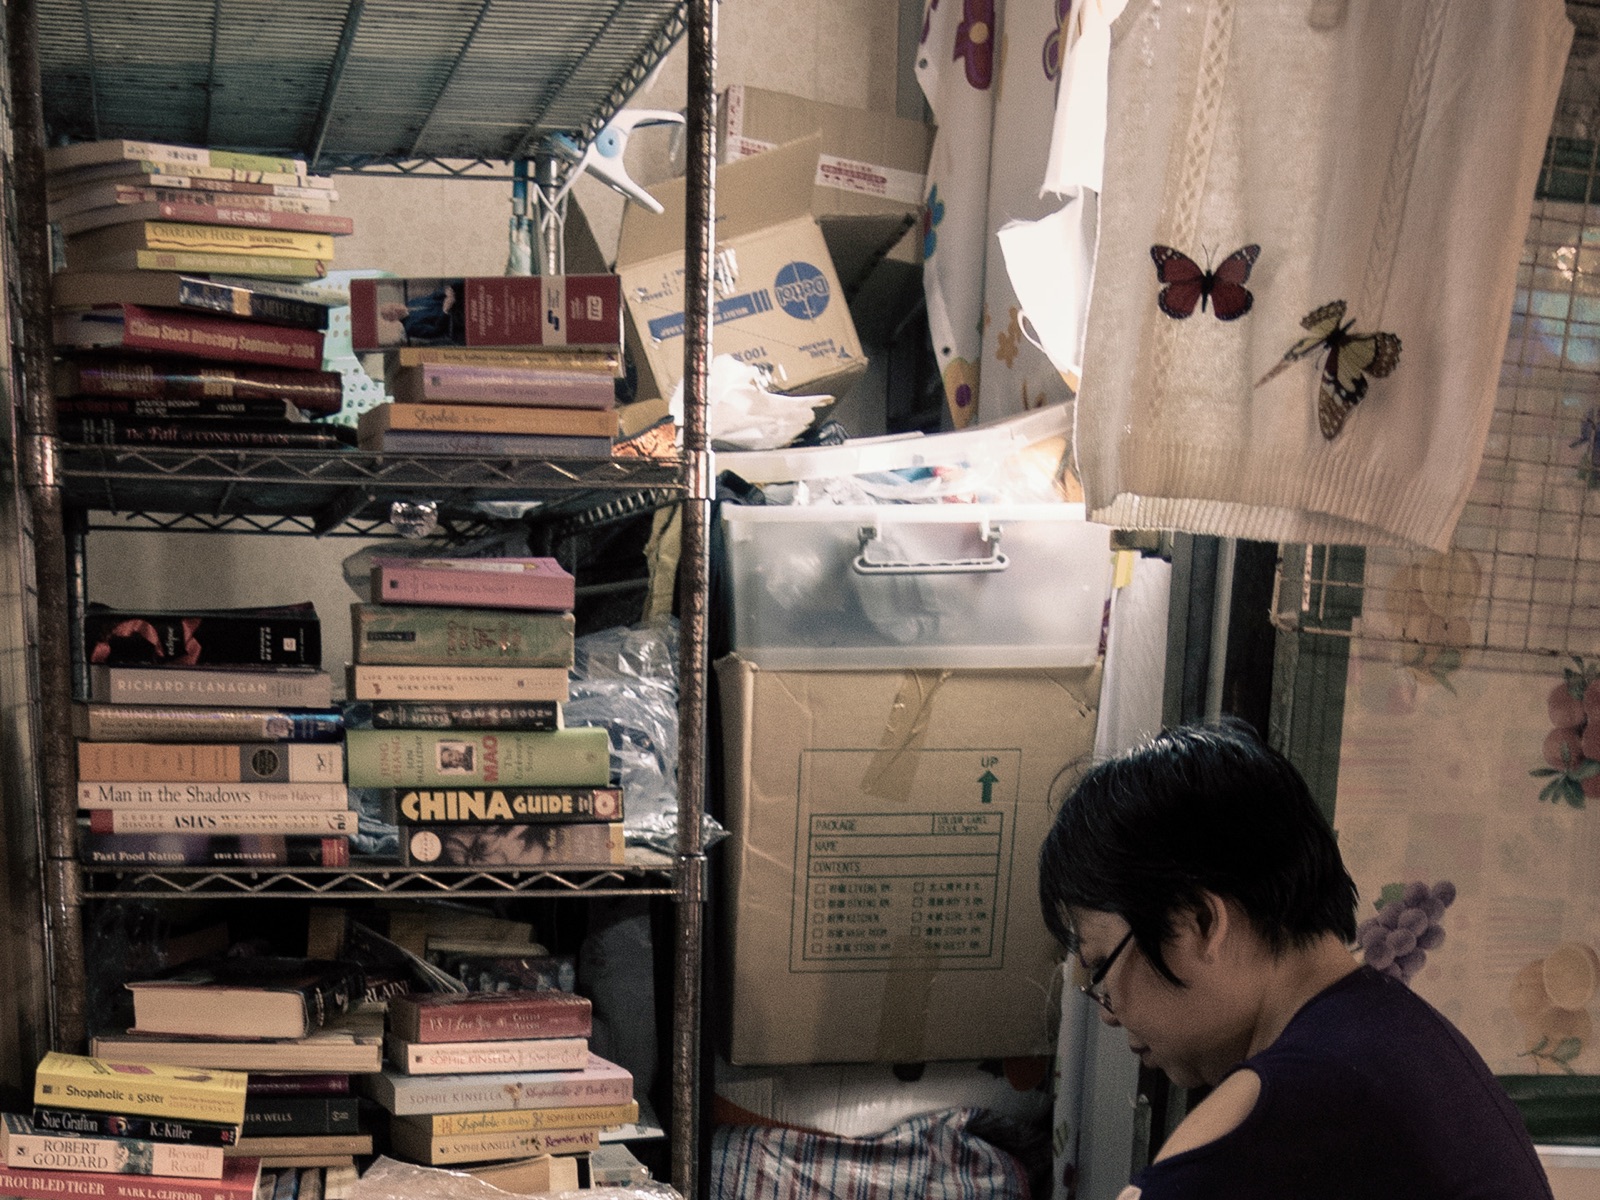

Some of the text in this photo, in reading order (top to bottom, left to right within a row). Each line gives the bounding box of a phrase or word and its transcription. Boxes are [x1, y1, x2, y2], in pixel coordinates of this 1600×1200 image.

[210, 229, 244, 241] HARRIS
[775, 275, 829, 304] Dettol
[129, 321, 161, 339] China
[162, 325, 190, 343] Stock
[191, 329, 238, 350] Directory
[238, 335, 291, 356] September
[117, 680, 268, 694] RICHARD FLANAGAN
[482, 734, 499, 783] MAO
[981, 755, 999, 769] UP
[99, 785, 132, 803] Man
[138, 785, 153, 802] in
[159, 785, 182, 803] the
[186, 785, 252, 803] Shadows
[400, 790, 574, 821] CHINA GUIDE
[172, 815, 217, 829] ASIA'S
[92, 851, 185, 863] Fast Food Nation
[813, 861, 861, 874] CONTENTS
[429, 1054, 467, 1066] SOPHIE
[468, 1052, 517, 1064] KINSELLA
[66, 1085, 125, 1101] Shopaholic
[137, 1093, 164, 1105] Sister
[409, 1095, 448, 1105] SOPHIE
[452, 1091, 503, 1103] KINSELLA
[264, 1113, 293, 1122] WELLS
[546, 1113, 576, 1122] SOPHIE
[577, 1110, 616, 1121] KINSELLA
[41, 1110, 62, 1128] Sue
[62, 1112, 98, 1132] Grafton
[164, 1122, 193, 1140] Killer
[43, 1140, 100, 1155] ROBERT
[168, 1147, 210, 1161] Beyond
[33, 1154, 109, 1169] GODDARD
[170, 1160, 205, 1174] Recall
[67, 1180, 106, 1196] TIGER
[118, 1187, 146, 1199] MARK
